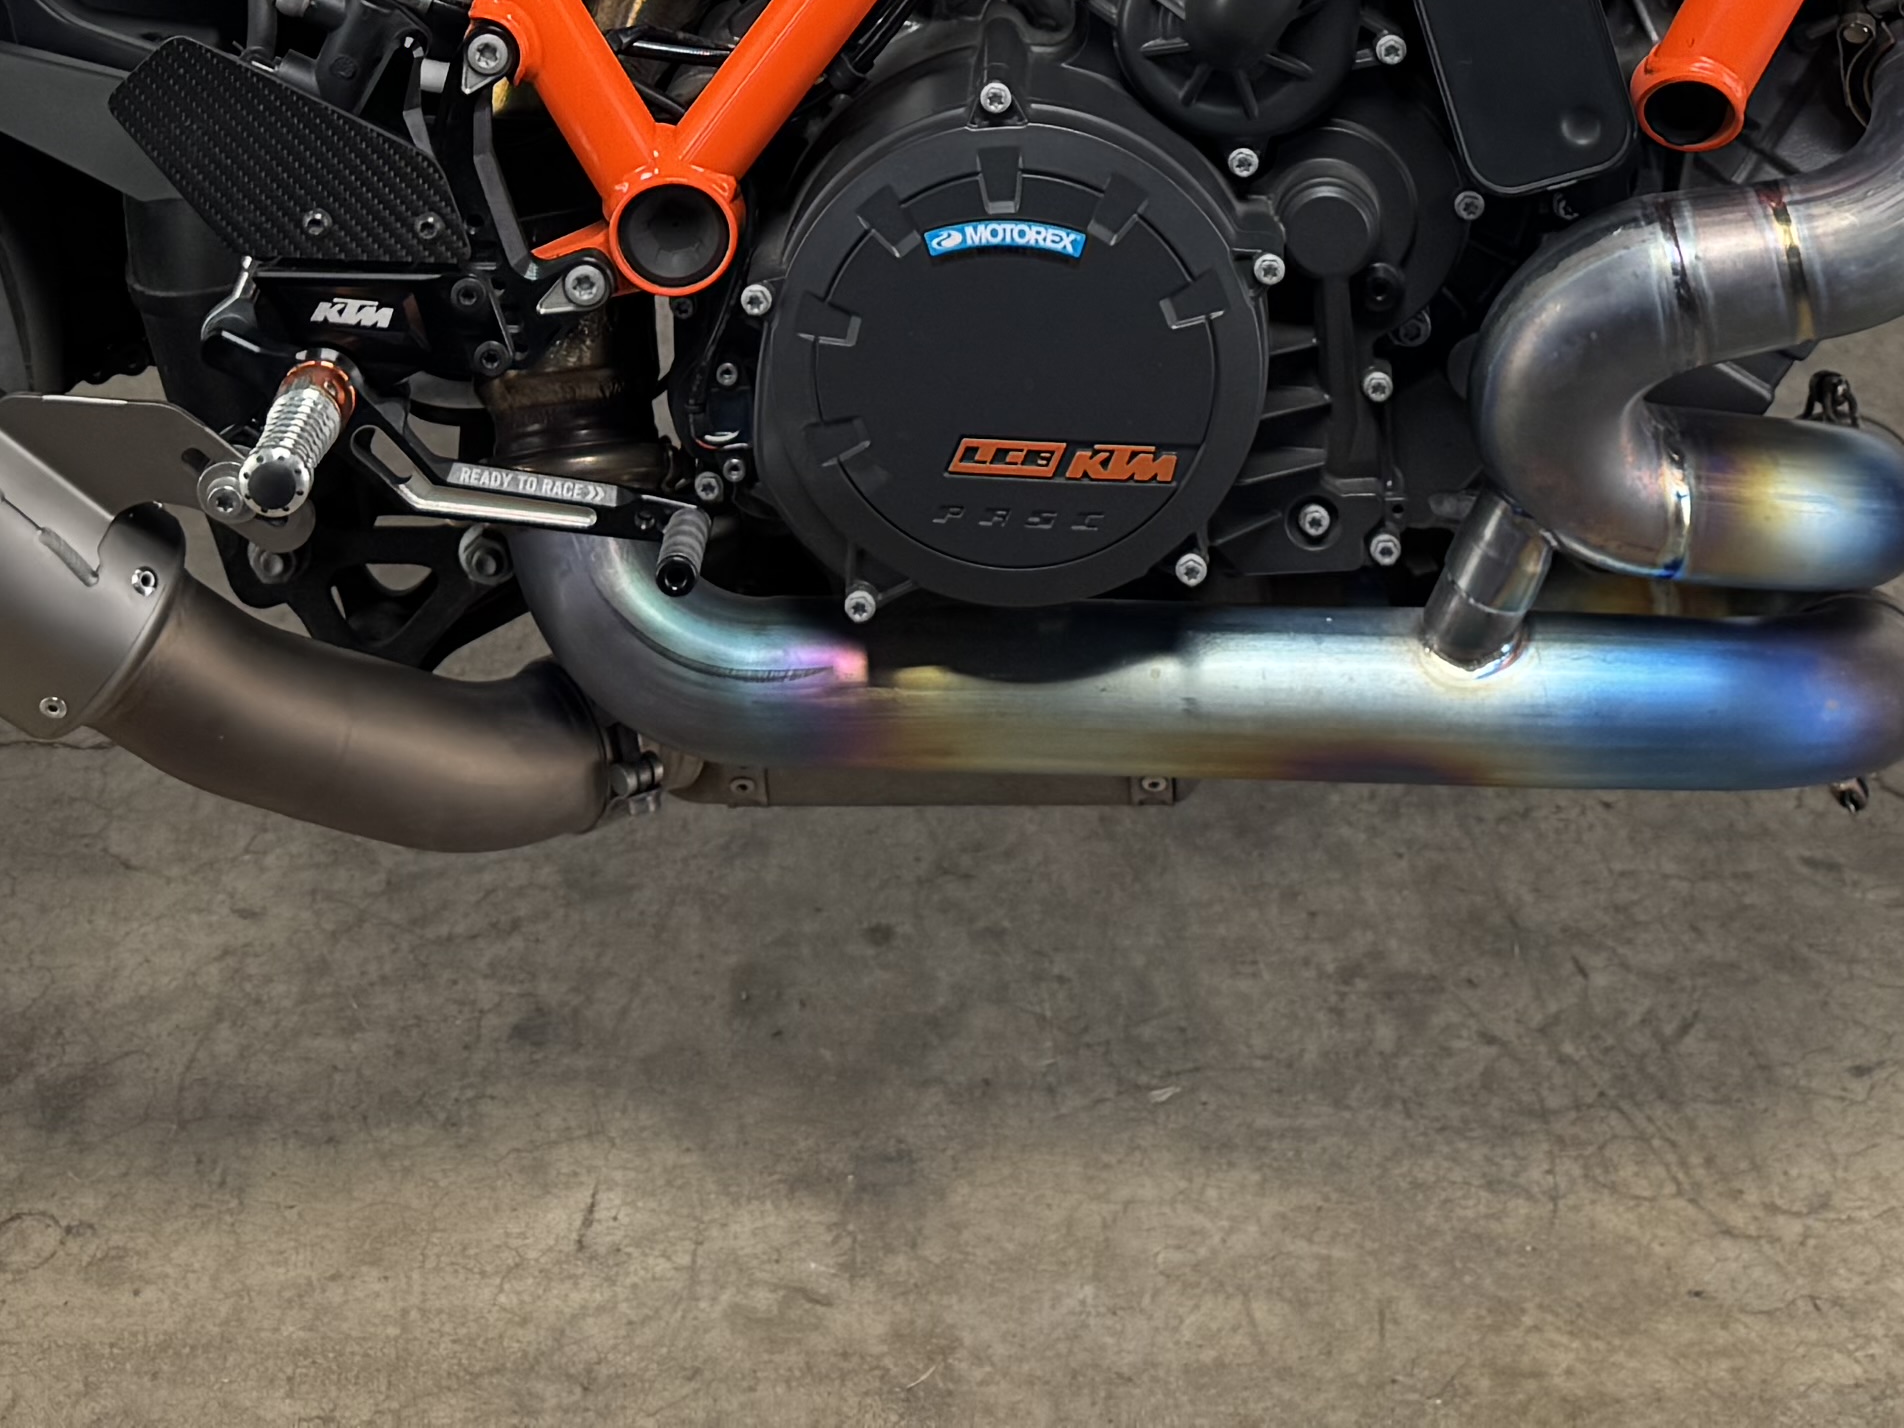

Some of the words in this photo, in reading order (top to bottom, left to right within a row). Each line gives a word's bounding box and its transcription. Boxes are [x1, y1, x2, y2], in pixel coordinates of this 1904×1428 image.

[963, 223, 1076, 253] MOTOREX
[309, 296, 395, 329] KTM
[1065, 443, 1179, 483] KTM
[458, 466, 511, 490] READY
[517, 471, 540, 492] TO
[542, 480, 584, 501] RACE
